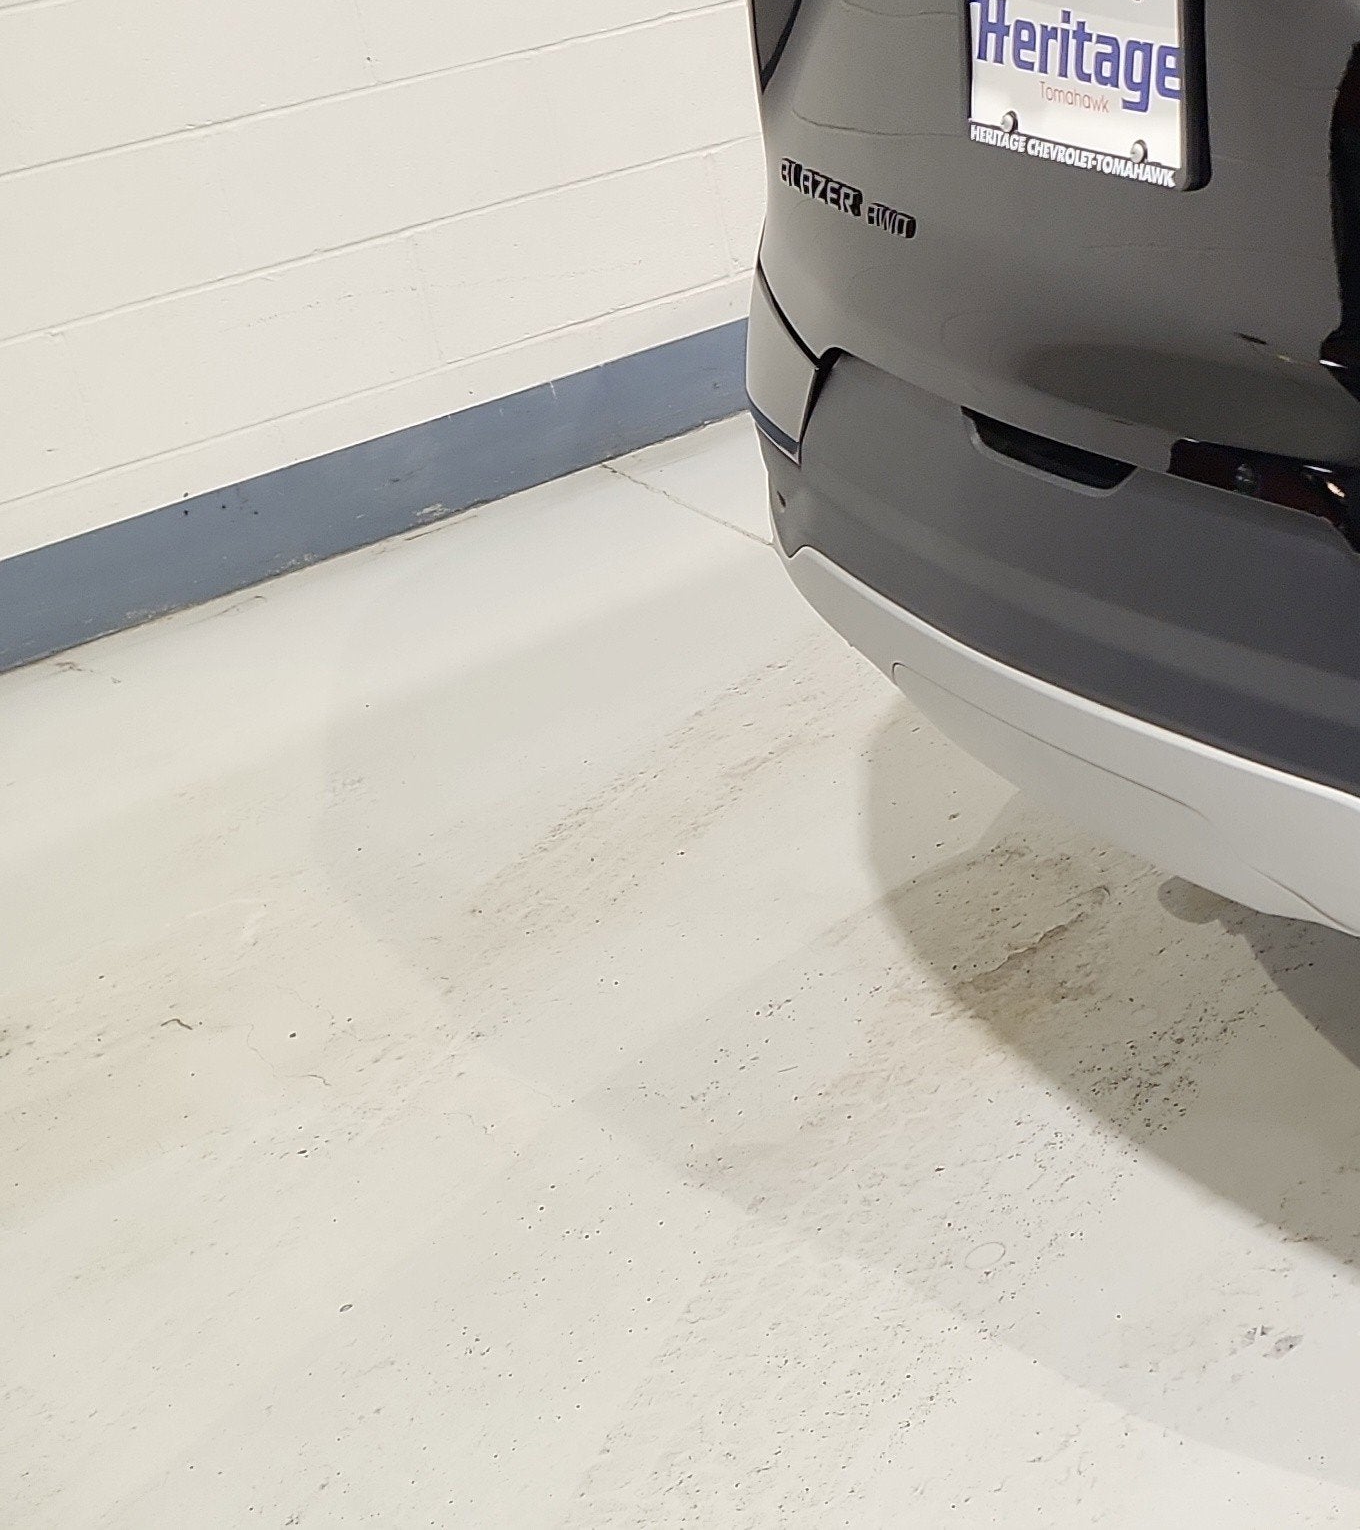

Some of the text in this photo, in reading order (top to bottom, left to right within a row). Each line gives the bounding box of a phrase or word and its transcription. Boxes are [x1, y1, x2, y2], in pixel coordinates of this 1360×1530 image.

[1039, 80, 1110, 114] Tomahawk
[970, 124, 1027, 153] HERITAGE
[781, 156, 917, 239] BLAZER AWD
